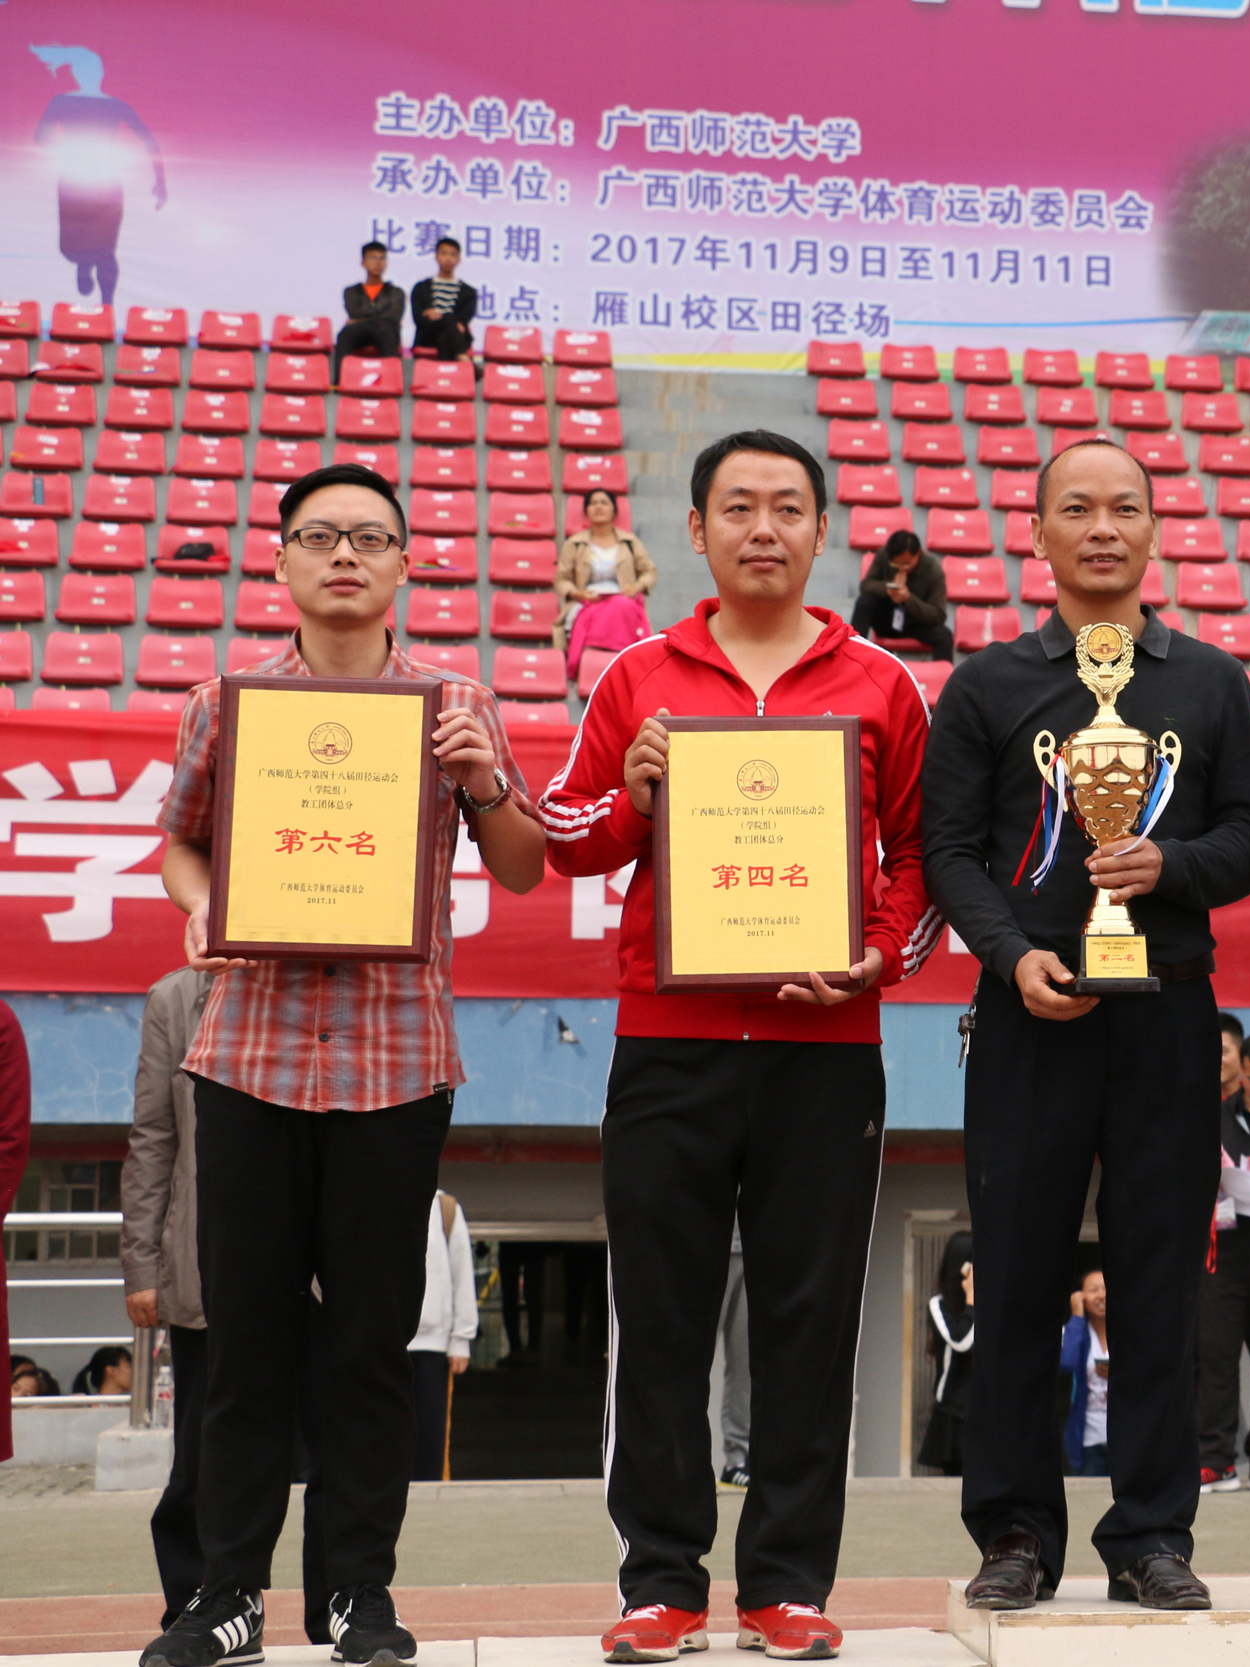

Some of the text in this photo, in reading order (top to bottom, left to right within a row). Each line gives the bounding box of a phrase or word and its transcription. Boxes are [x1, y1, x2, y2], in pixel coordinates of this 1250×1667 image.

[258, 768, 399, 783] 广西师范大学第四十八届田径运动会
[300, 798, 354, 810] 教工团体总分
[691, 805, 825, 817] 广西师范大学第四十八届田径运动会
[274, 827, 376, 857] 第六名
[733, 834, 784, 845] 教工团体总分
[711, 862, 809, 890] 第四名
[1098, 953, 1135, 962] 第二名
